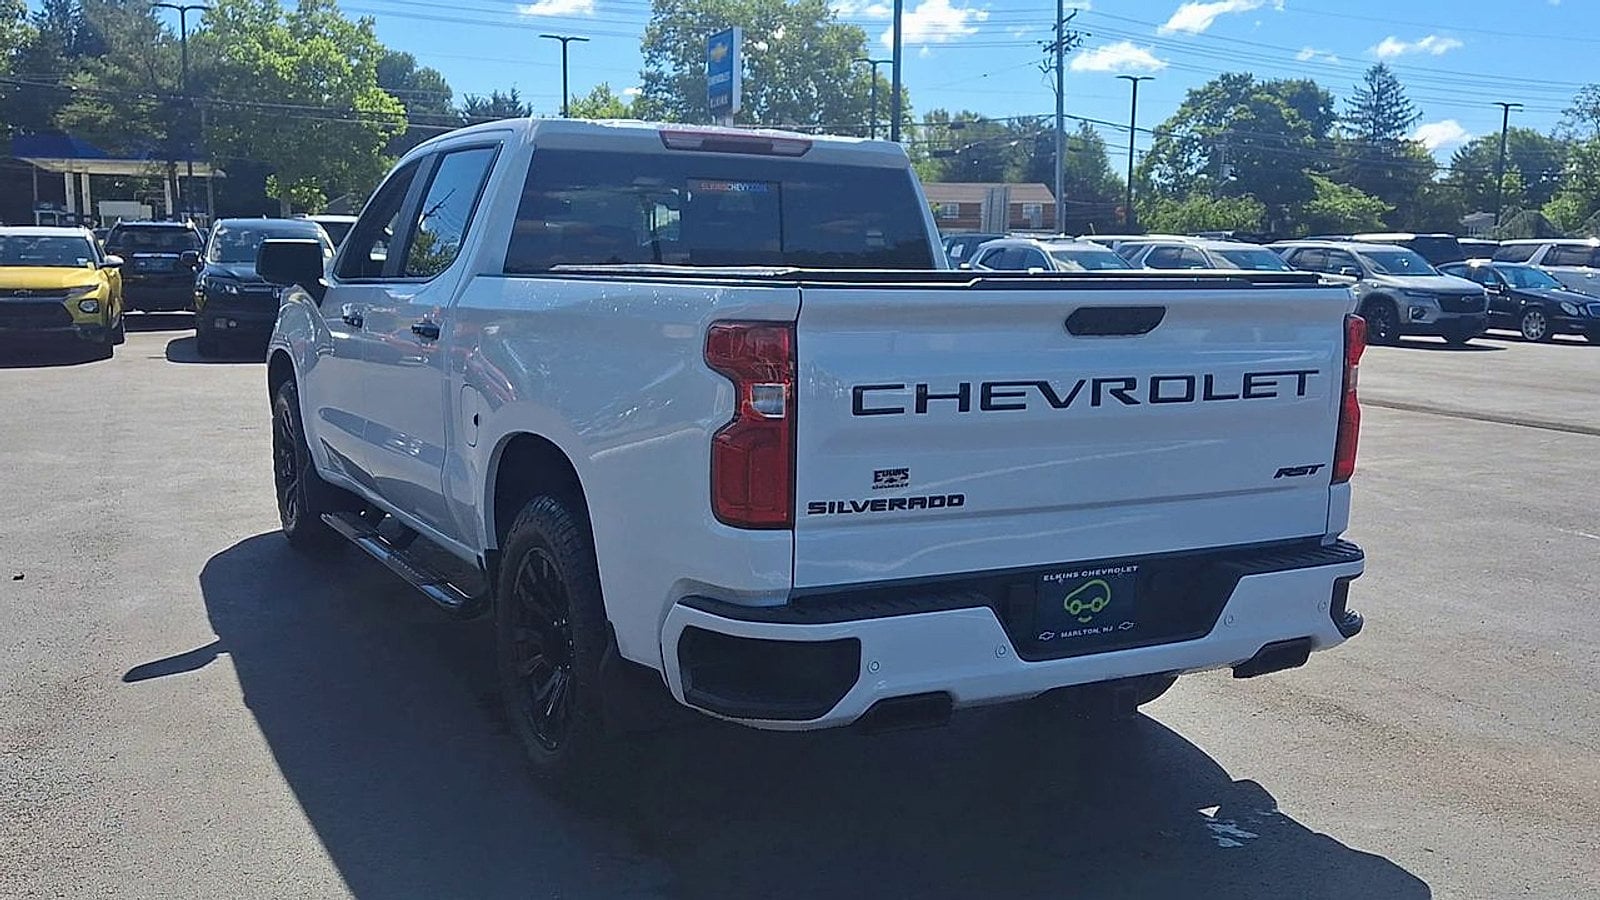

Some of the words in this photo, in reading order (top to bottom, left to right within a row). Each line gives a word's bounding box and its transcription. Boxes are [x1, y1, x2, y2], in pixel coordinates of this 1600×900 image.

[851, 369, 1320, 416] CHEVROLET
[1273, 463, 1326, 479] RST
[807, 493, 965, 515] SILVERADO
[1043, 571, 1079, 581] ELKINS
[1081, 565, 1138, 577] CHEVROLET
[1061, 627, 1101, 638] MARLTON,
[1102, 625, 1114, 633] NJ
